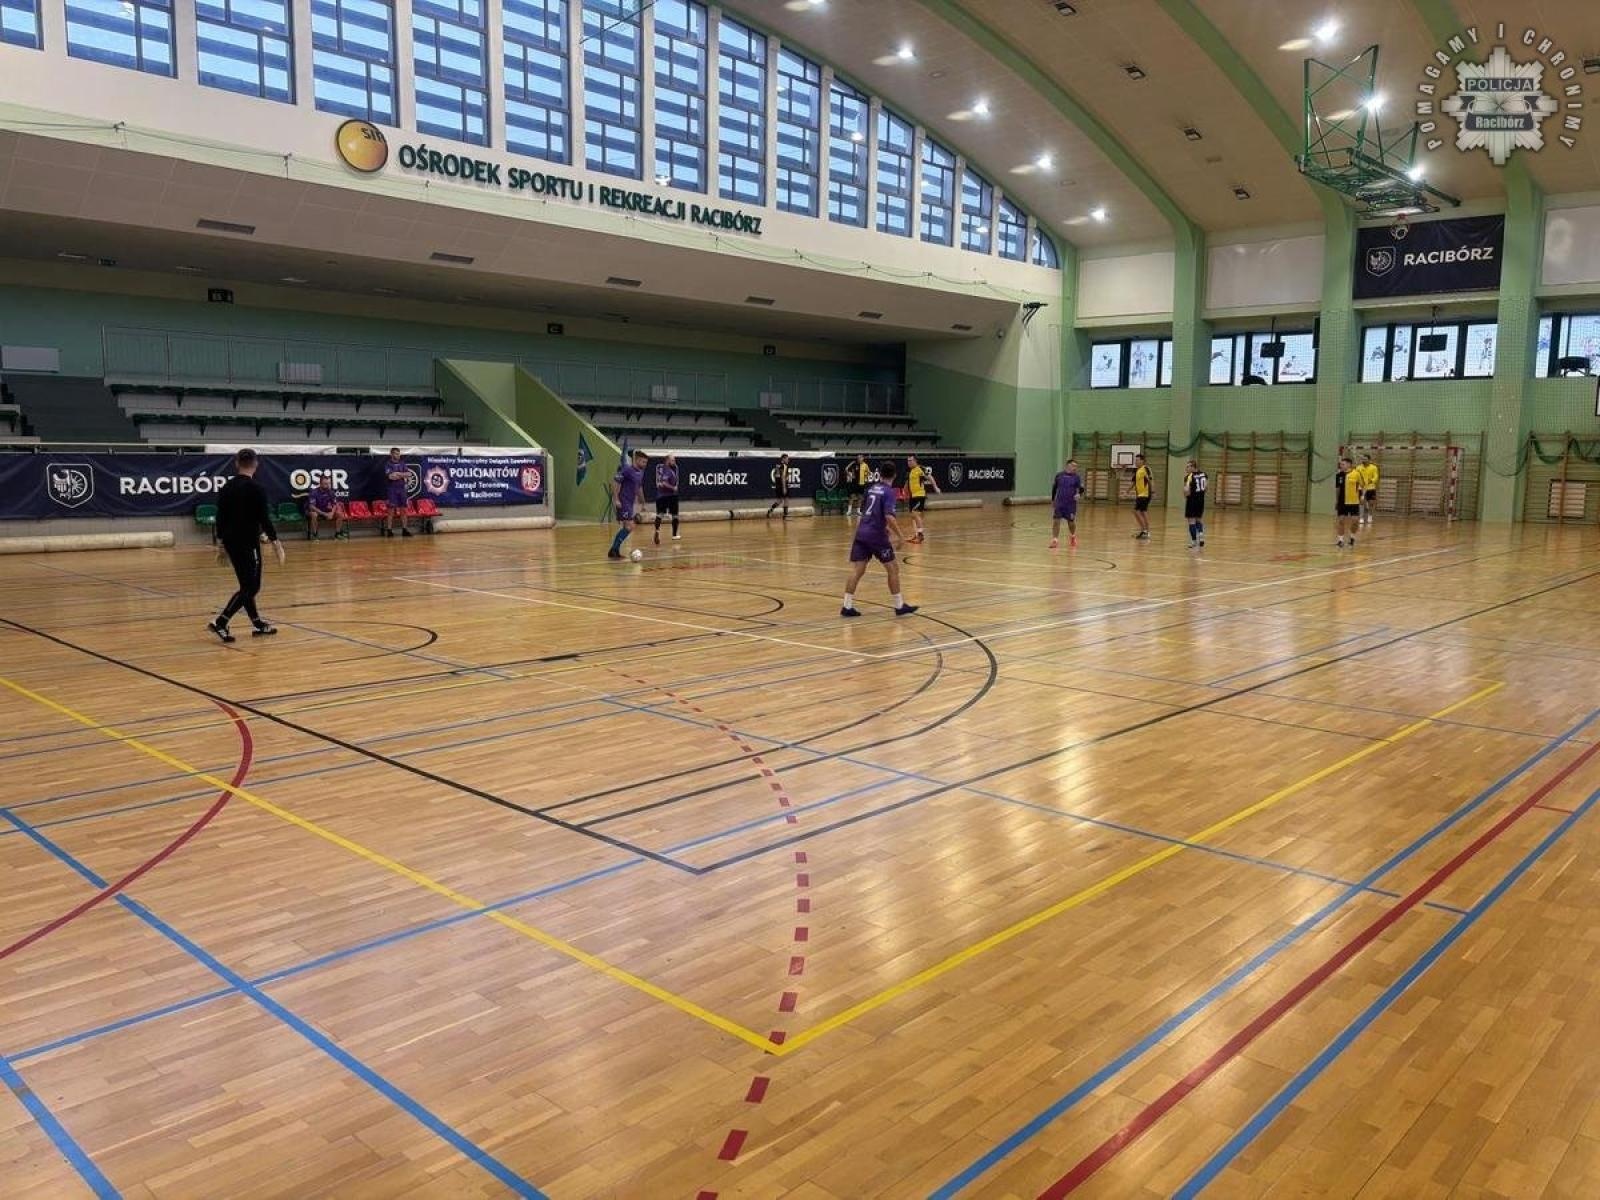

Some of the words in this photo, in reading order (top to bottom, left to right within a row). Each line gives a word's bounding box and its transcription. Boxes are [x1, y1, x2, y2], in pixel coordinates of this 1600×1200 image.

[399, 144, 501, 185] OŚRODEK
[508, 167, 583, 200] SPORTU
[588, 183, 594, 203] I
[600, 185, 686, 220] REKREACJI
[691, 204, 762, 234] RACIBÓRZ
[1404, 245, 1494, 266] RACIBÓRZ
[449, 466, 520, 478] POLICJANTÓW
[689, 468, 748, 486] RACIBÓRZ
[968, 467, 1005, 480] RACIBÓRZ
[120, 471, 235, 495] RACIBÓR
[1195, 477, 1206, 492] 10
[865, 494, 876, 515] 2
